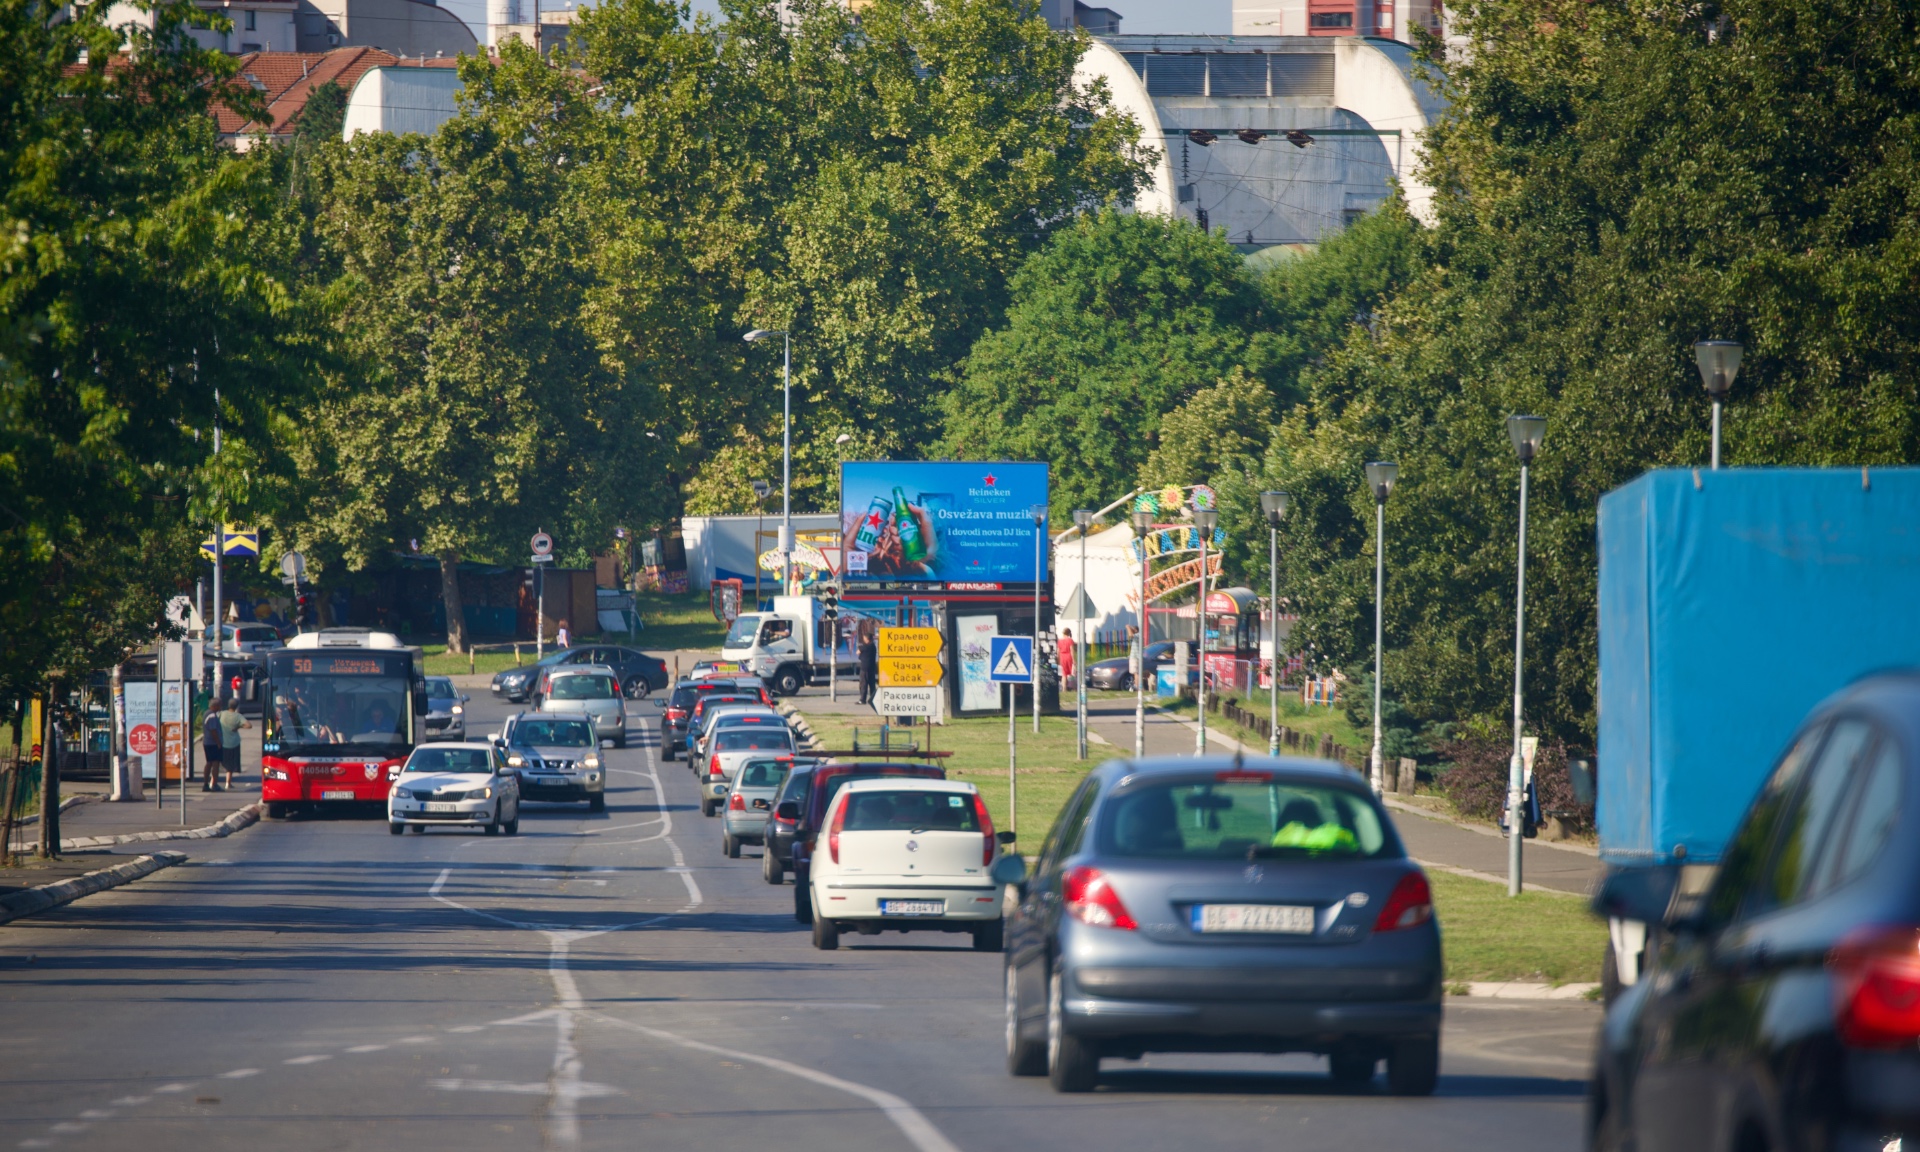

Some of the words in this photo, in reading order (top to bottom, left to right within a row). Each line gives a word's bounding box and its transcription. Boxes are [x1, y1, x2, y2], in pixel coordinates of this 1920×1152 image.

[968, 488, 1011, 496] Heineken
[938, 509, 993, 519] Osvežava
[996, 509, 1034, 519] muzik
[952, 528, 981, 536] dovodi
[1004, 528, 1014, 536] DJ
[1015, 528, 1031, 536] lica
[1180, 527, 1226, 550] PAK
[887, 632, 929, 641] Краљево
[887, 644, 926, 653] Kraljevo
[294, 659, 312, 673] 50
[893, 672, 922, 682] Čačak
[883, 691, 931, 700] Раковица
[884, 703, 927, 712] Rakovica
[131, 731, 148, 741] -15
